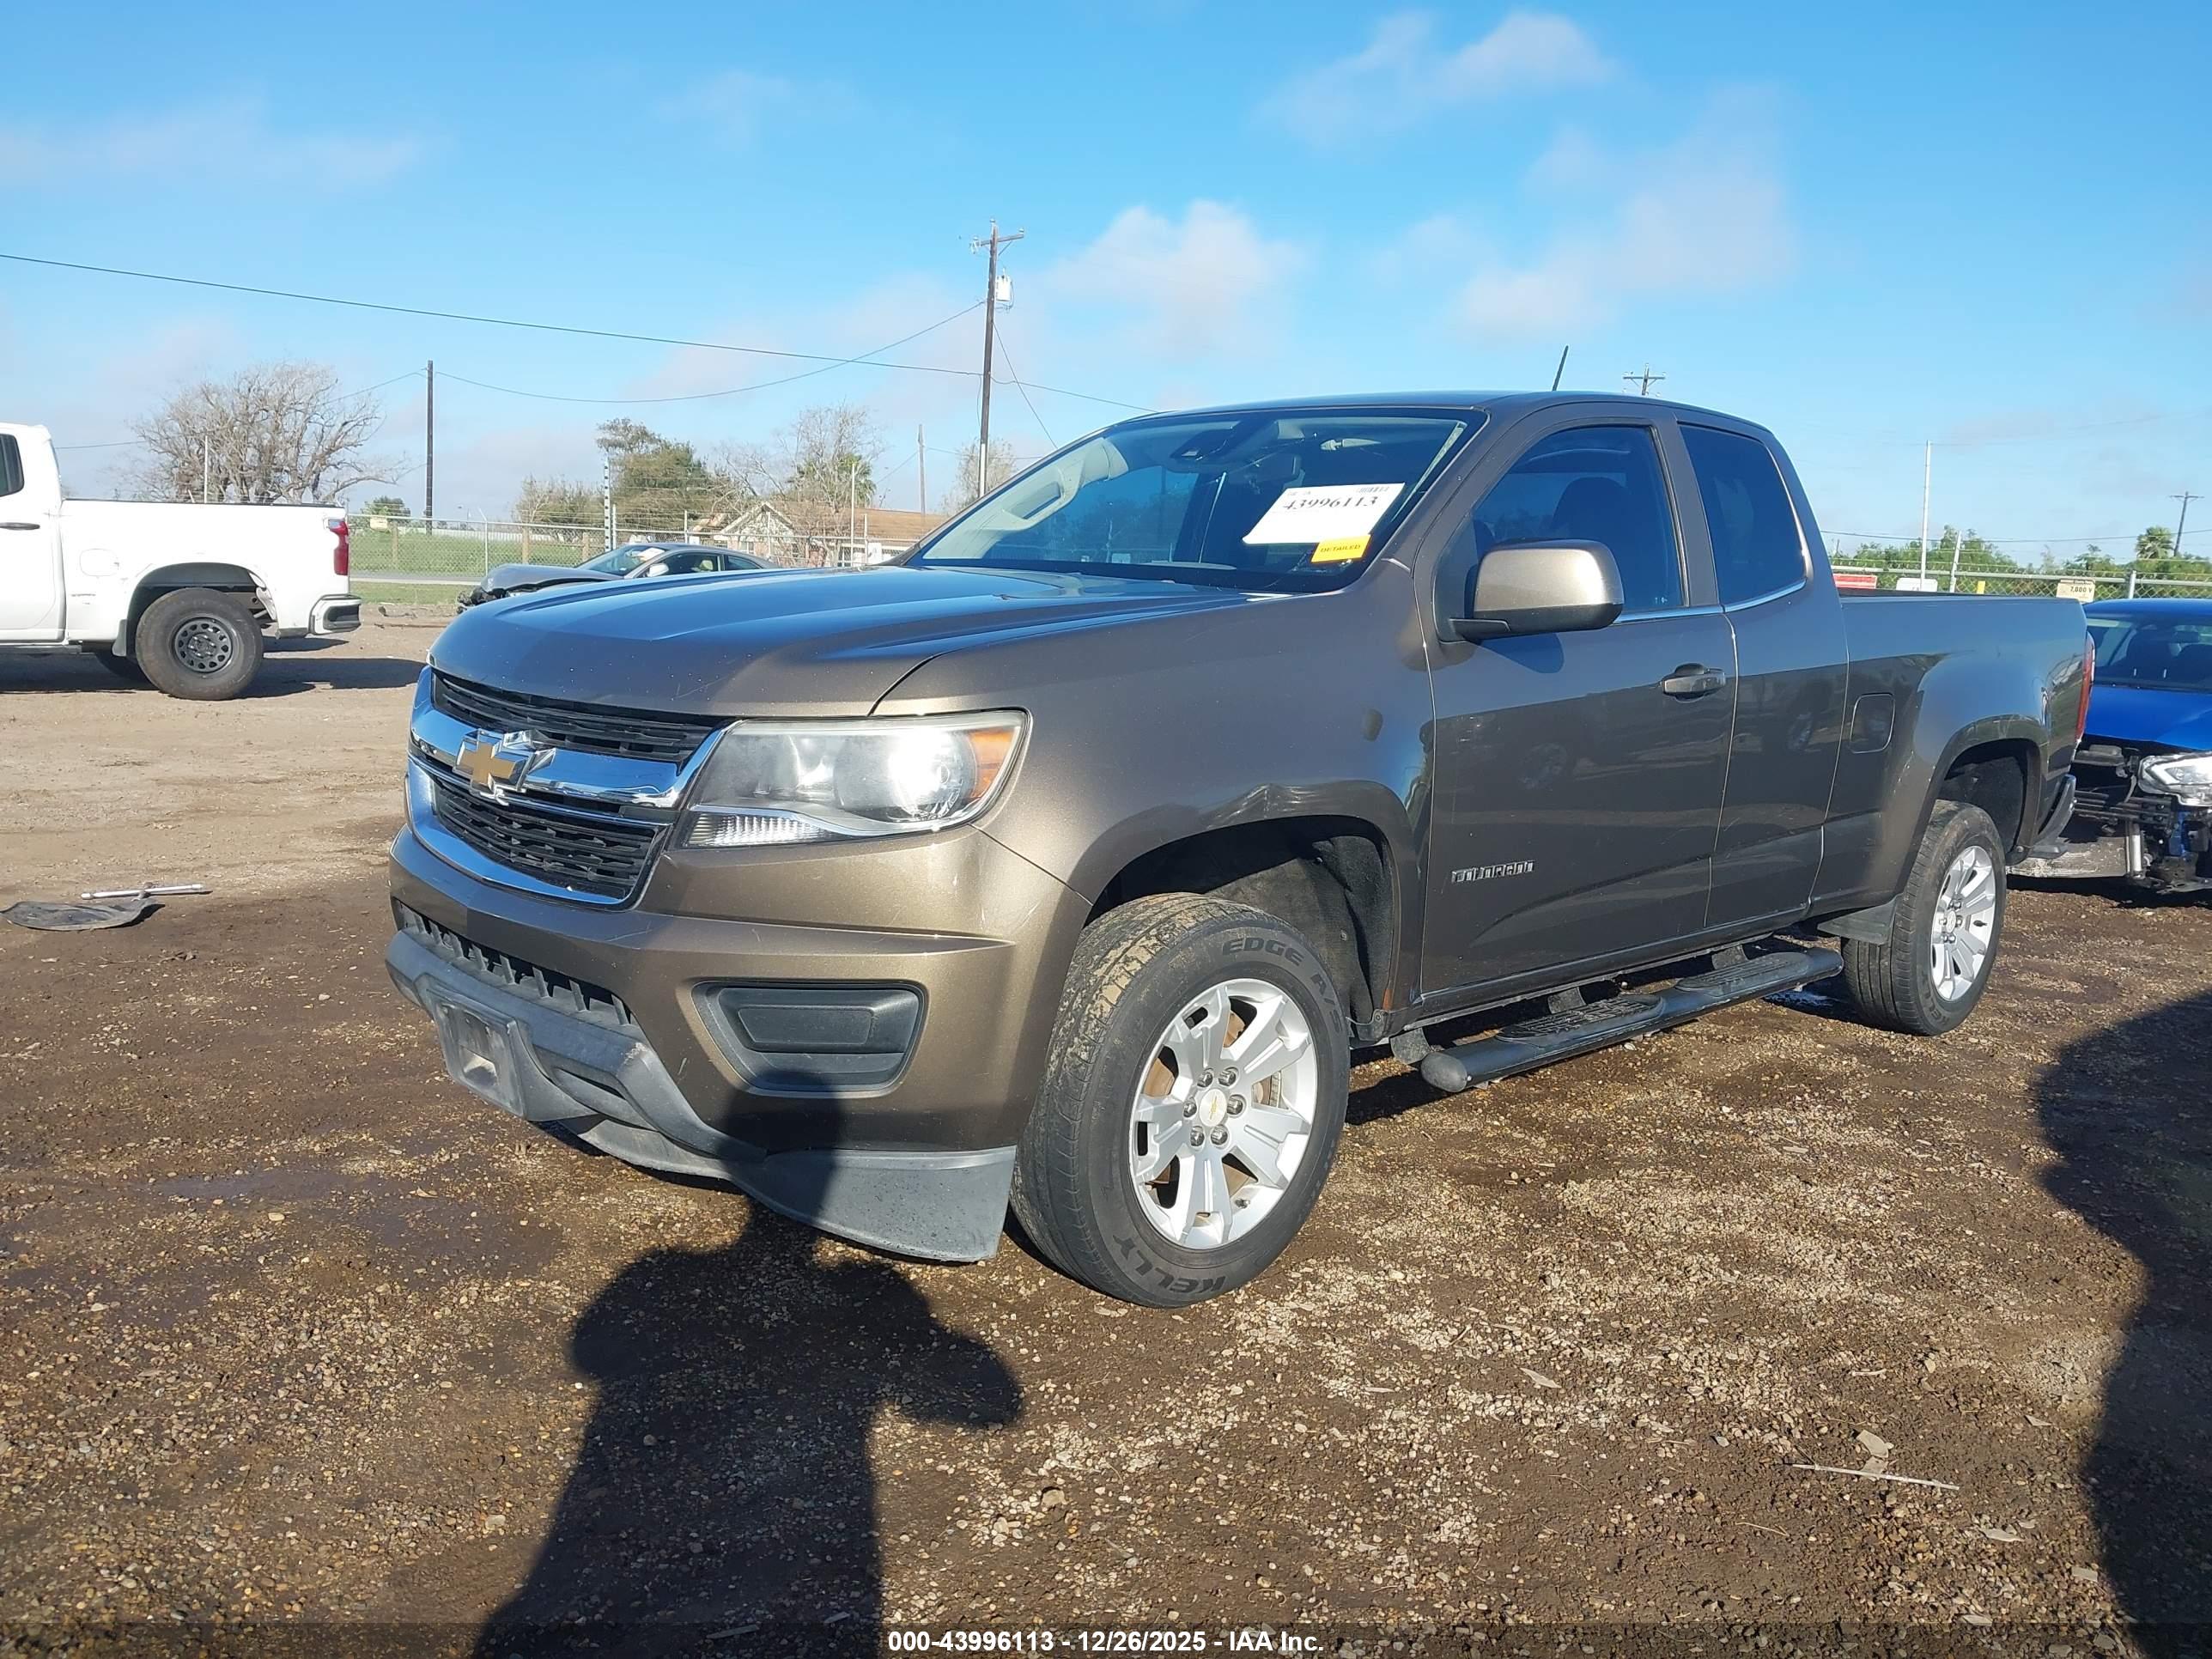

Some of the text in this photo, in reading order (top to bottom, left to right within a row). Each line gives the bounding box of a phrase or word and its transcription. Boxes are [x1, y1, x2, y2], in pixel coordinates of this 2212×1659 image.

[1283, 495, 1378, 509] 43996113
[1451, 860, 1534, 883] COLORADO
[1222, 937, 1343, 1034] EDGE A/S
[1113, 1235, 1226, 1293] KELLY
